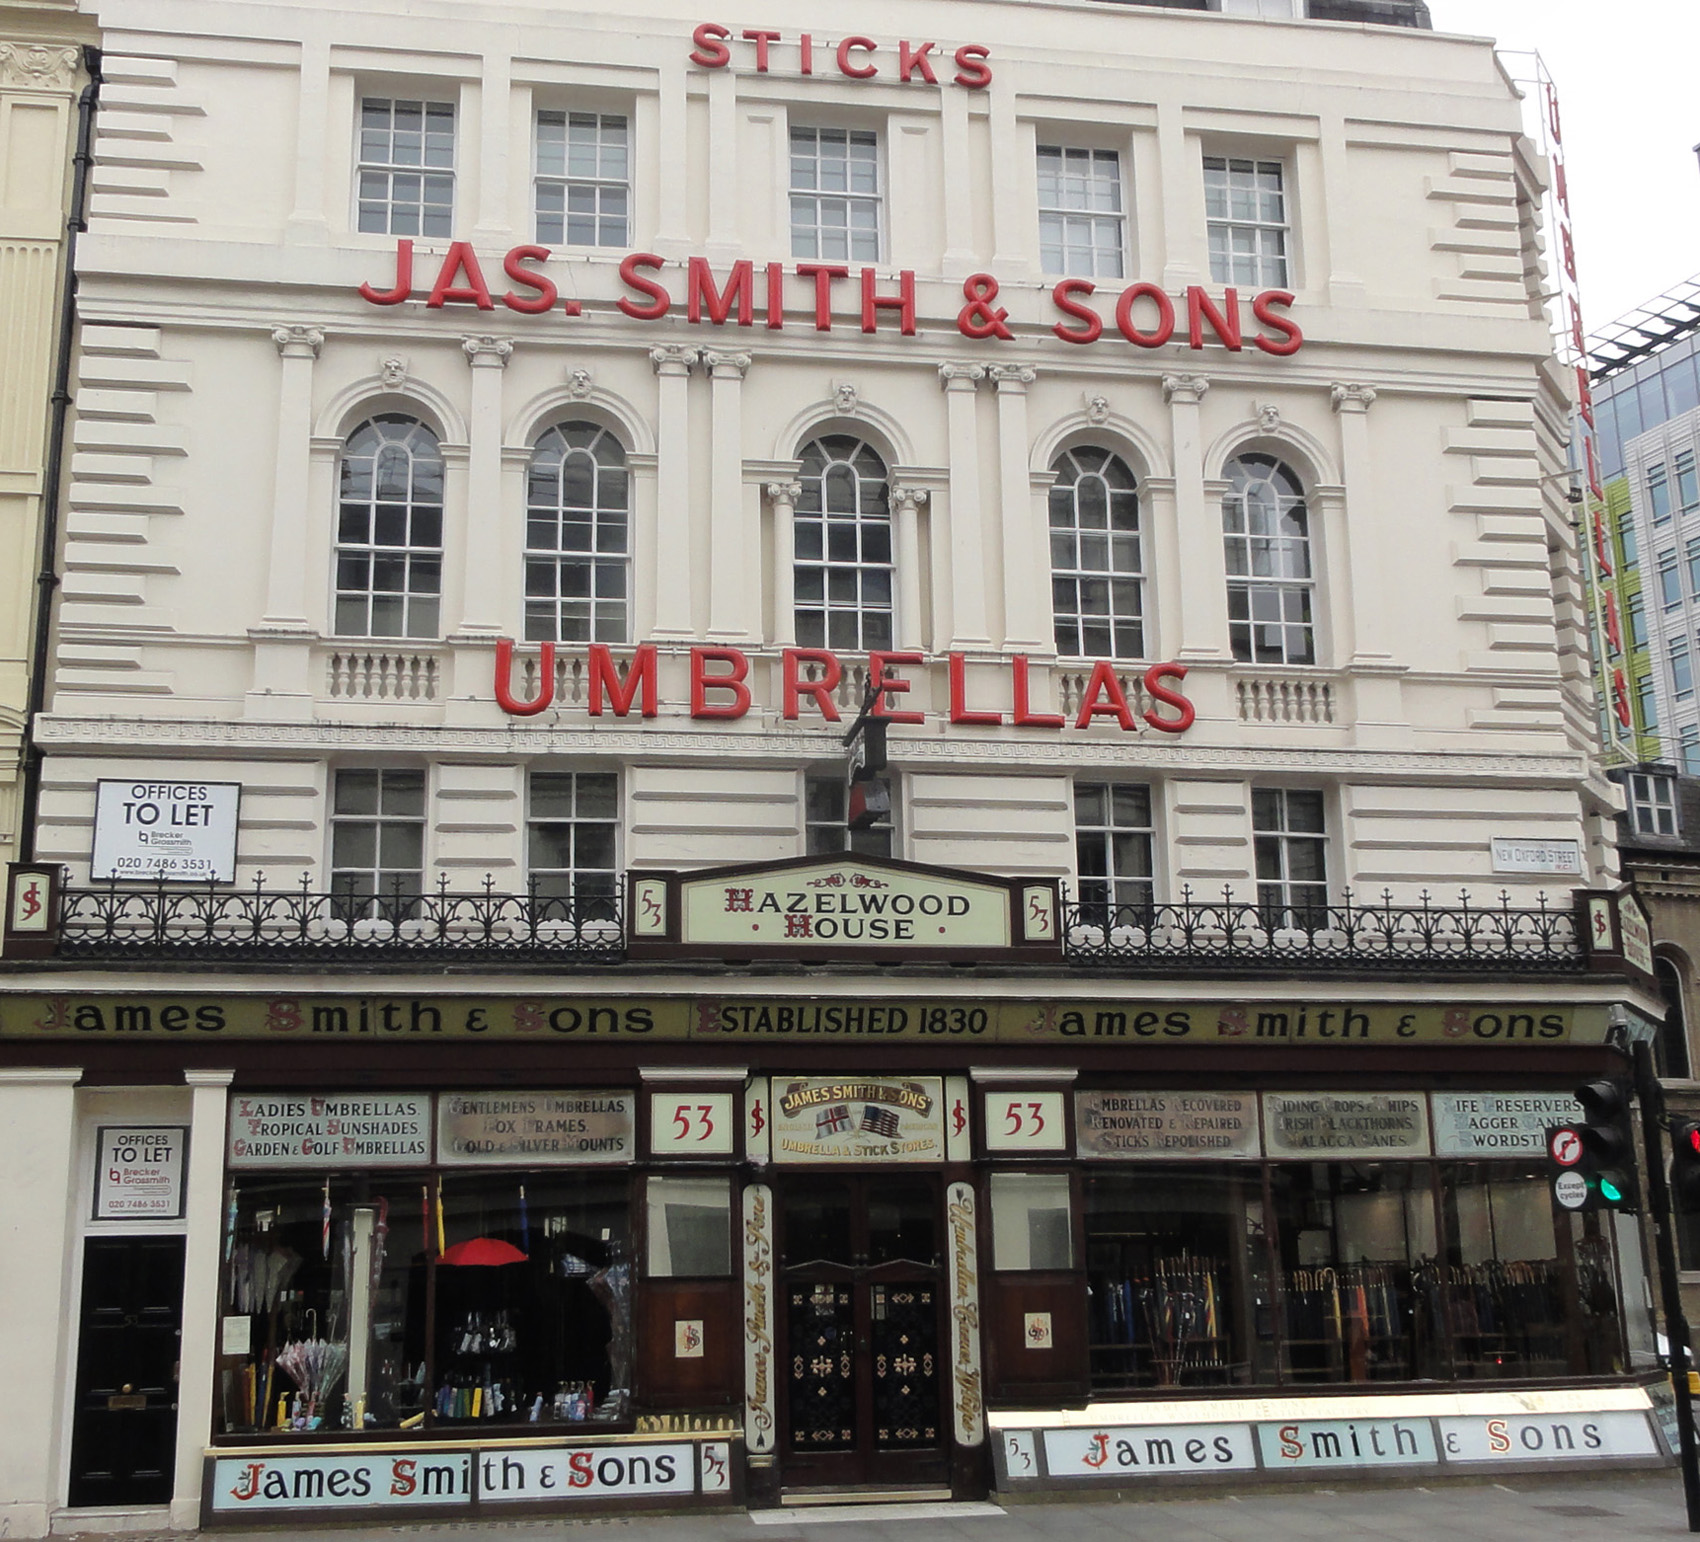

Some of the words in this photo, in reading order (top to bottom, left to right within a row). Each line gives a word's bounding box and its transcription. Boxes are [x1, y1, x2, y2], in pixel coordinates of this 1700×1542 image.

[689, 22, 993, 90] STICKS
[359, 238, 582, 317] JAS.
[616, 252, 917, 336] SMITH
[957, 272, 1016, 341] &
[1051, 278, 1304, 355] SONS
[494, 638, 1197, 733] UMBRELLAS
[131, 785, 208, 801] OFFICES
[123, 803, 160, 825] TO
[171, 804, 213, 827] LET
[151, 831, 184, 839] Brecker
[117, 857, 142, 868] 020
[146, 858, 178, 869] 7486
[181, 859, 212, 870] 3531
[1548, 850, 1576, 864] STREET
[642, 889, 662, 927] 53
[724, 887, 971, 916] HAZELWOOD
[1029, 895, 1049, 932] 53
[784, 914, 915, 940] HOUSE
[33, 999, 227, 1033] James
[265, 999, 443, 1033] Smith
[511, 1001, 655, 1034] Sons
[697, 1001, 909, 1034] ESTABLISHED
[918, 1008, 989, 1034] 1830
[1024, 1004, 1191, 1037] James
[1216, 1004, 1371, 1038] Smith
[1442, 1007, 1565, 1038] Sons
[239, 1099, 306, 1118] LADIES
[784, 1086, 831, 1110] JAMES
[832, 1085, 878, 1100] SMITH
[248, 1119, 323, 1137] TROPICAL
[672, 1104, 714, 1141] 53
[1005, 1102, 1045, 1137] 53
[118, 1135, 168, 1146] OFFICES
[233, 1138, 290, 1157] GARDEN
[301, 1138, 340, 1156] GOLF
[343, 1137, 426, 1156] UMBRELLAS
[781, 1138, 843, 1157] UMBRELLA
[853, 1142, 890, 1157] STICK
[112, 1147, 137, 1163] TO
[144, 1147, 173, 1163] LET
[123, 1168, 161, 1176] Brecker
[123, 1176, 171, 1184] Grossmith
[1557, 1181, 1585, 1191] Except
[1560, 1190, 1585, 1200] cycles
[108, 1200, 125, 1209] 020
[127, 1200, 148, 1208] 7486
[746, 1195, 771, 1255] Sons
[746, 1284, 771, 1354] Smith
[746, 1352, 772, 1432] James
[1009, 1438, 1031, 1470] 53
[1081, 1433, 1234, 1467] James
[1279, 1423, 1419, 1459] Smith
[1487, 1419, 1602, 1453] Sons
[230, 1463, 371, 1500] James
[390, 1456, 525, 1495] Smith
[567, 1451, 676, 1489] Sons
[703, 1446, 725, 1487] 53
